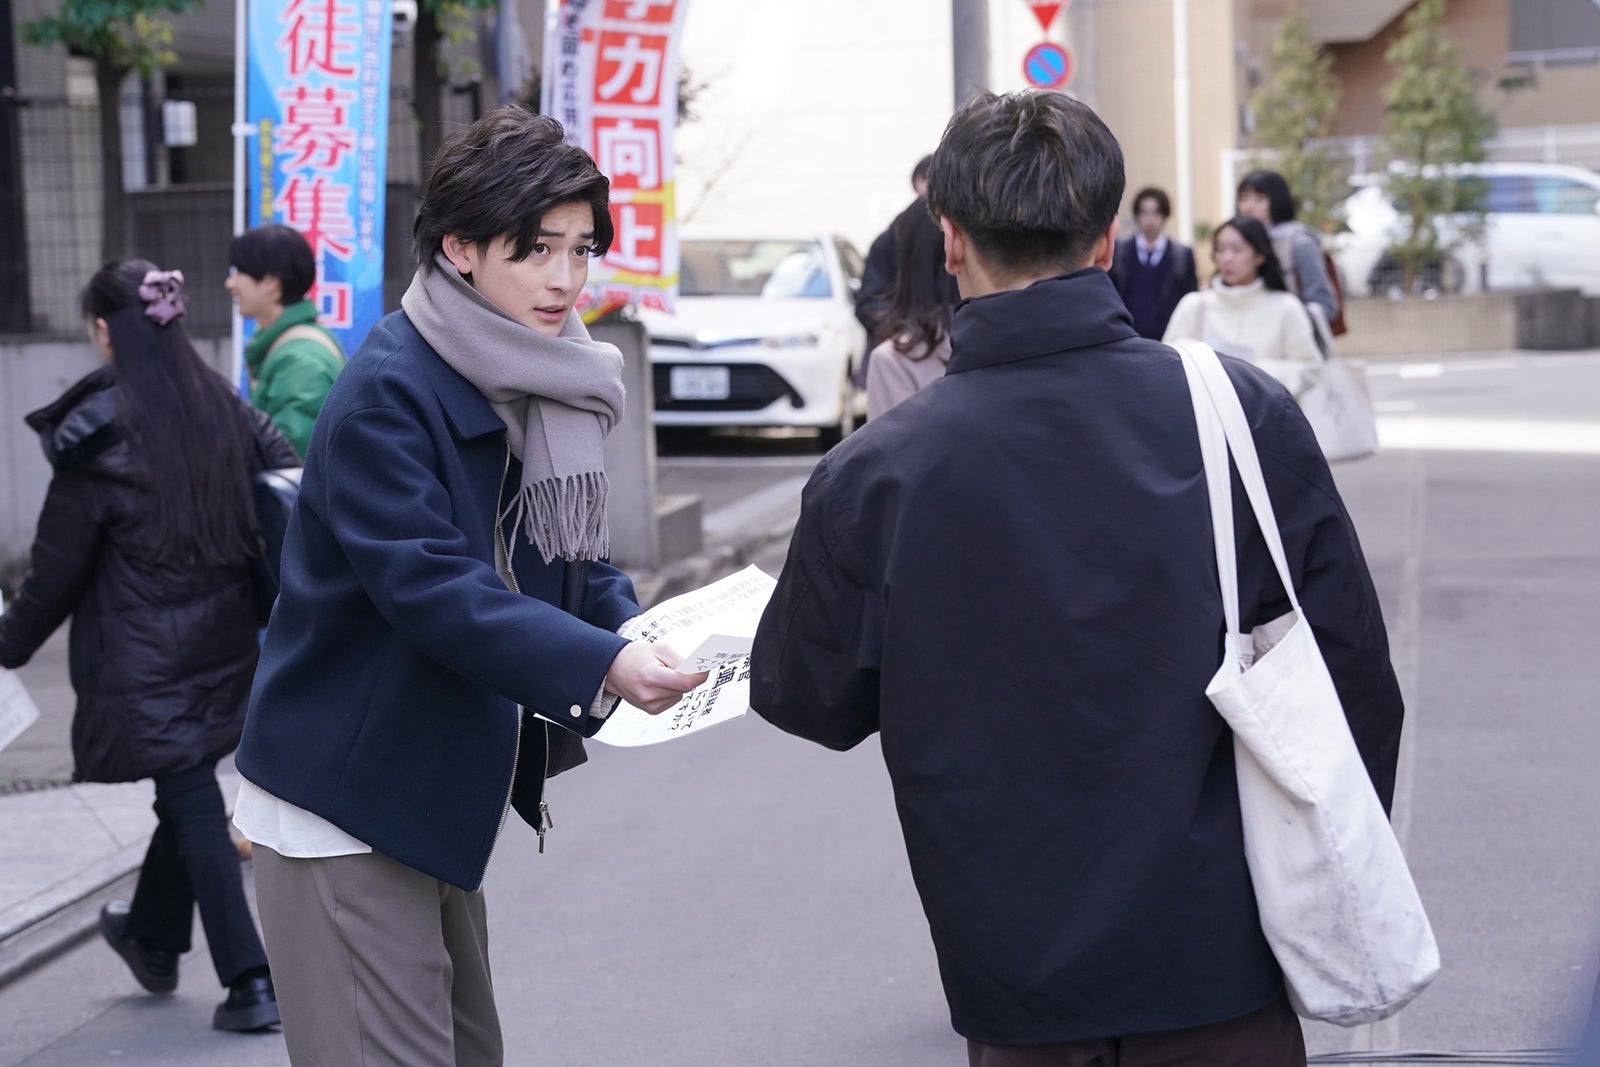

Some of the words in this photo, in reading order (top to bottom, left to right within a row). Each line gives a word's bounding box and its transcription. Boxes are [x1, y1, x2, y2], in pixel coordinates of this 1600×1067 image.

[668, 688, 695, 731] ですか?
[681, 689, 708, 730] について
